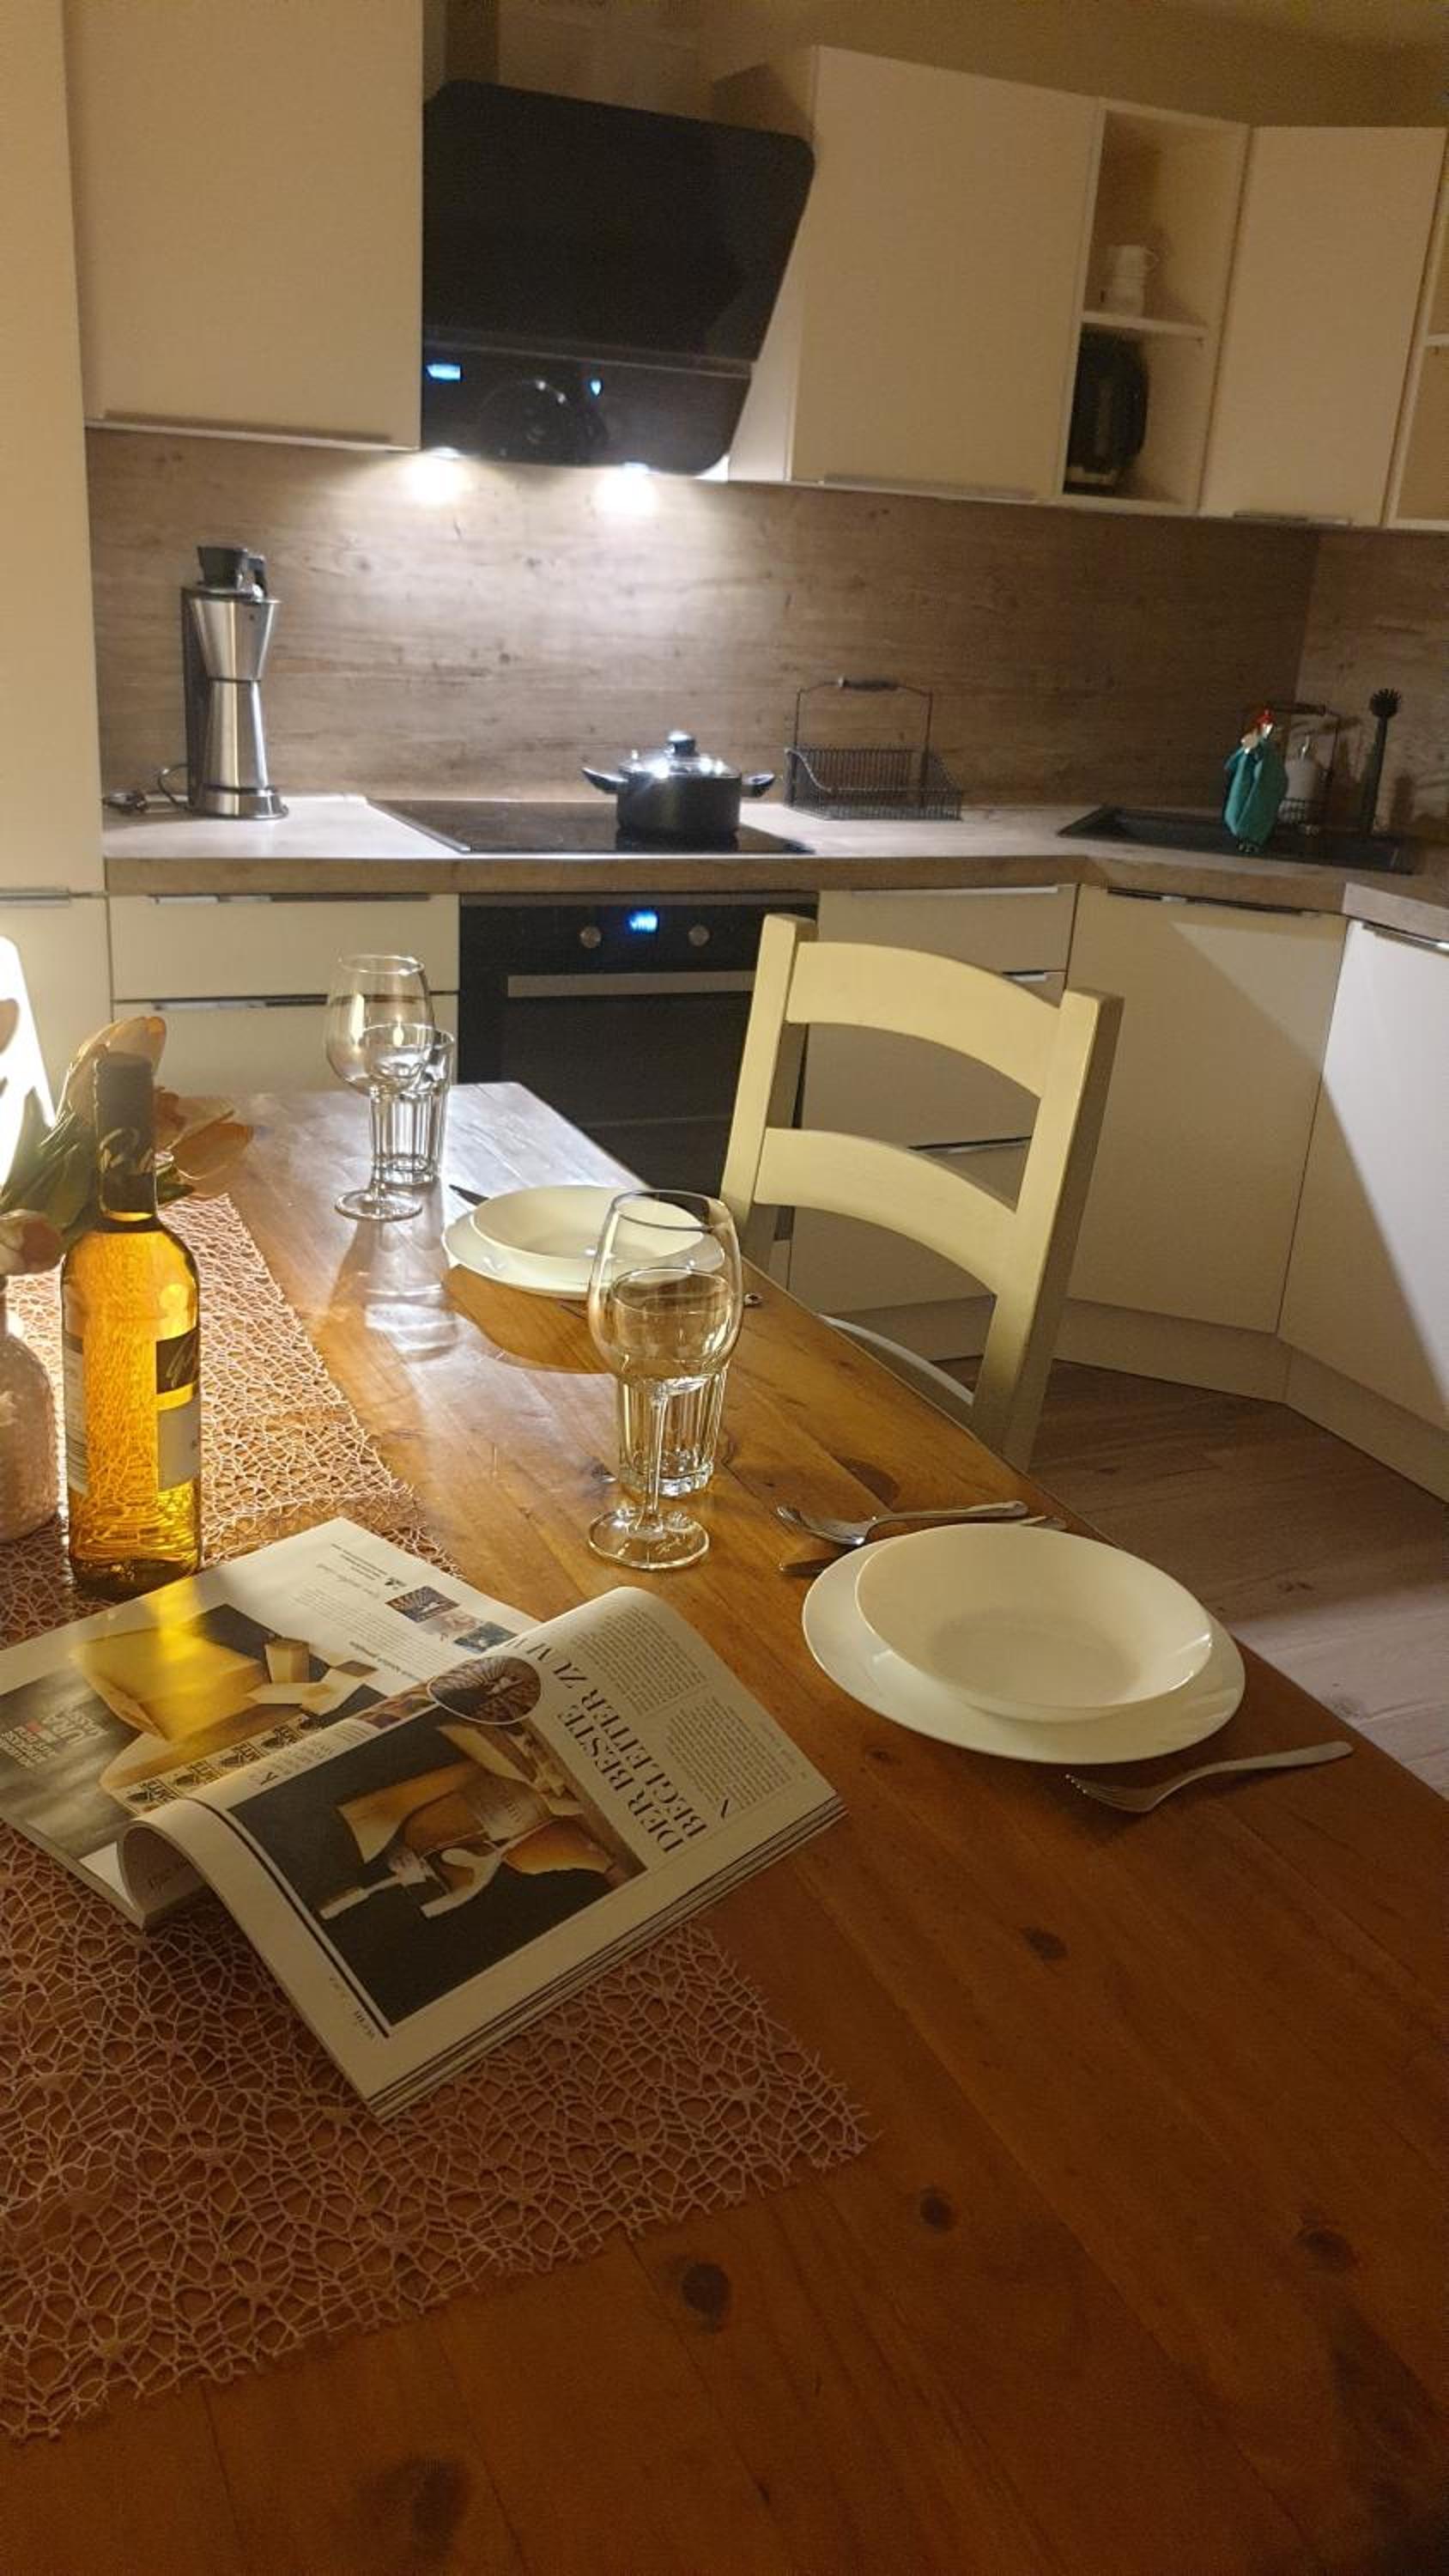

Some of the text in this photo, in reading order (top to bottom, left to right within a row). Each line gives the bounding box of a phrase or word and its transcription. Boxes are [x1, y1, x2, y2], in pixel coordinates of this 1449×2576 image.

[557, 1704, 635, 1791] BESTE
[581, 1689, 707, 1838] BEGLEITER
[627, 1789, 685, 1853] DER
